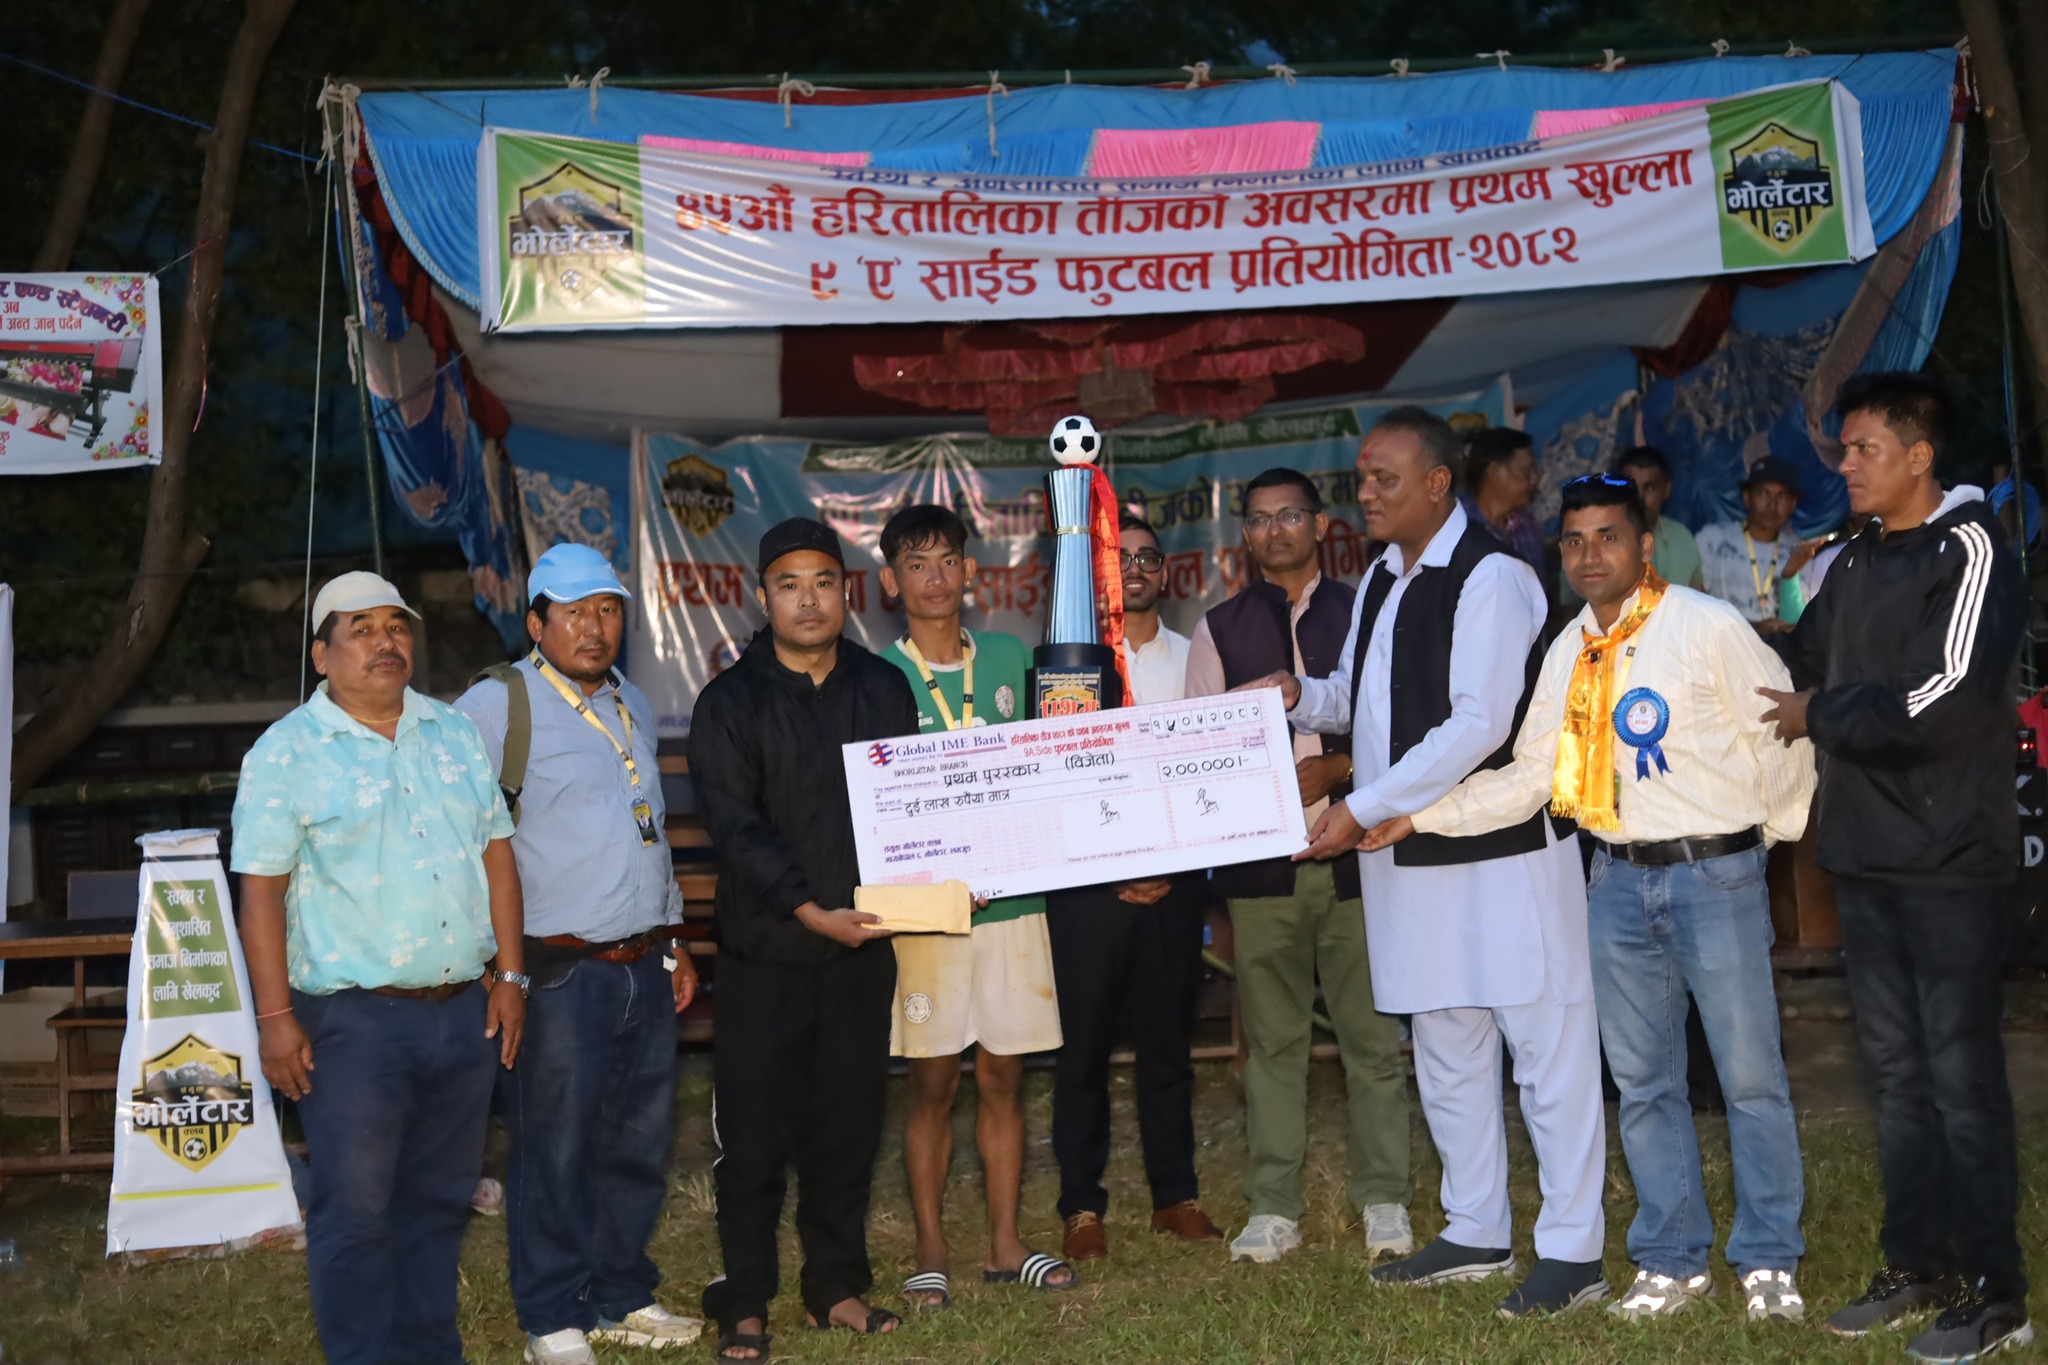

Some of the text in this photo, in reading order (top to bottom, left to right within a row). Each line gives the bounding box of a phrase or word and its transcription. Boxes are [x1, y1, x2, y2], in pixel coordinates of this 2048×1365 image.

[809, 187, 1063, 238] हरितालिका
[1242, 181, 1435, 229] अवसरमा
[1449, 166, 1552, 214] प्रथम
[1564, 149, 1694, 208] खुल्ला
[918, 248, 1040, 305] साईड
[1055, 252, 1214, 307] फुटबल
[895, 733, 1007, 757] Global IME Bank
[943, 750, 1115, 789] प्रथम पुरस्कार (विजेता)
[904, 799, 921, 817] दुई
[924, 797, 950, 812] लाख
[988, 788, 1011, 803] मात्र
[152, 979, 179, 1002] लागि
